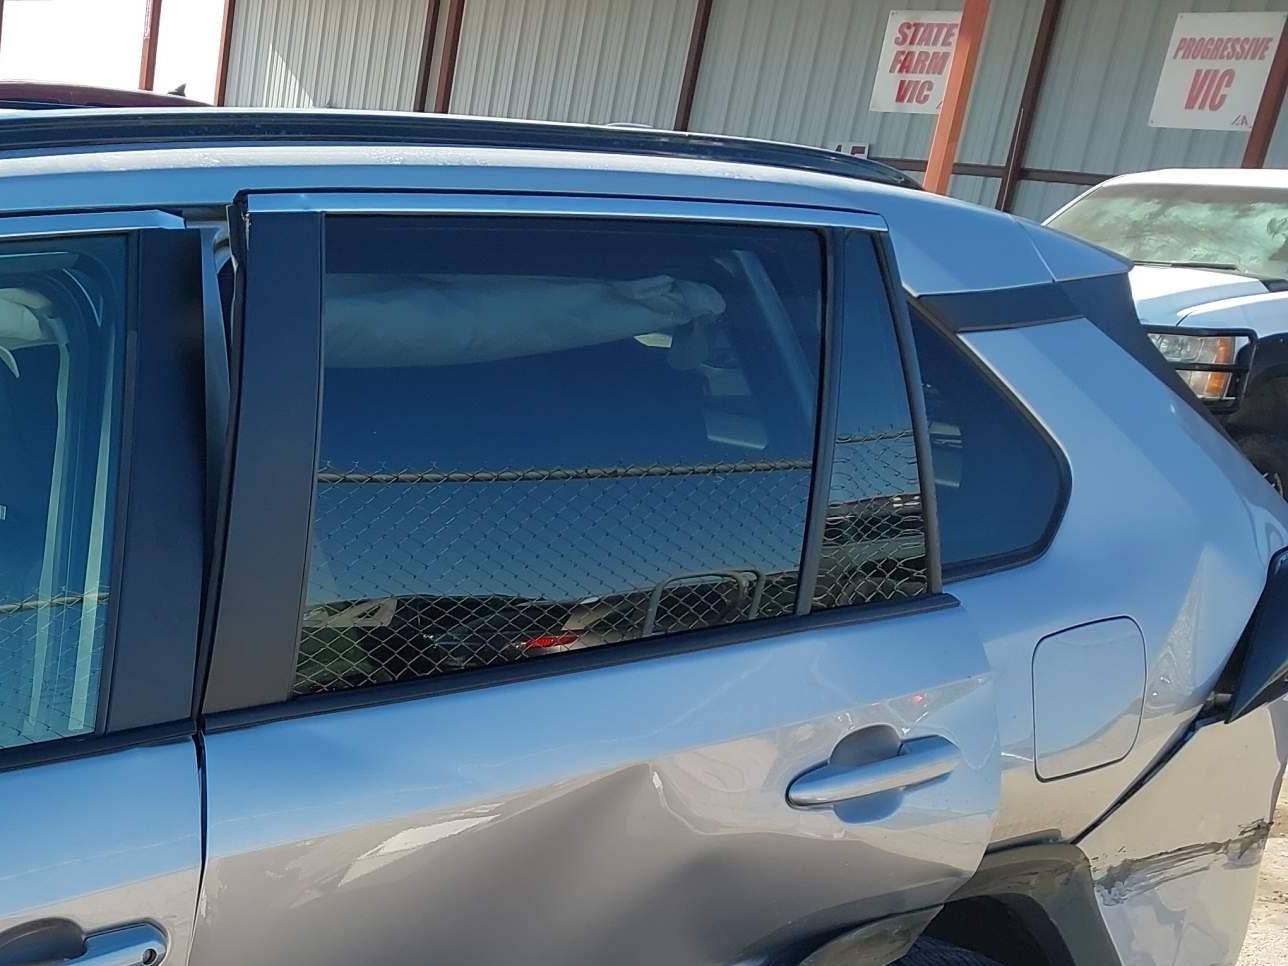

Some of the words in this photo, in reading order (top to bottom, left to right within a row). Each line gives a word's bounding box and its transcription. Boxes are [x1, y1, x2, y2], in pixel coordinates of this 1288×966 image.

[894, 22, 959, 46] STATE
[1173, 36, 1274, 61] PROGRESSIVE
[889, 51, 951, 75] FARM
[895, 80, 934, 104] VIC
[1184, 68, 1236, 111] VIC
